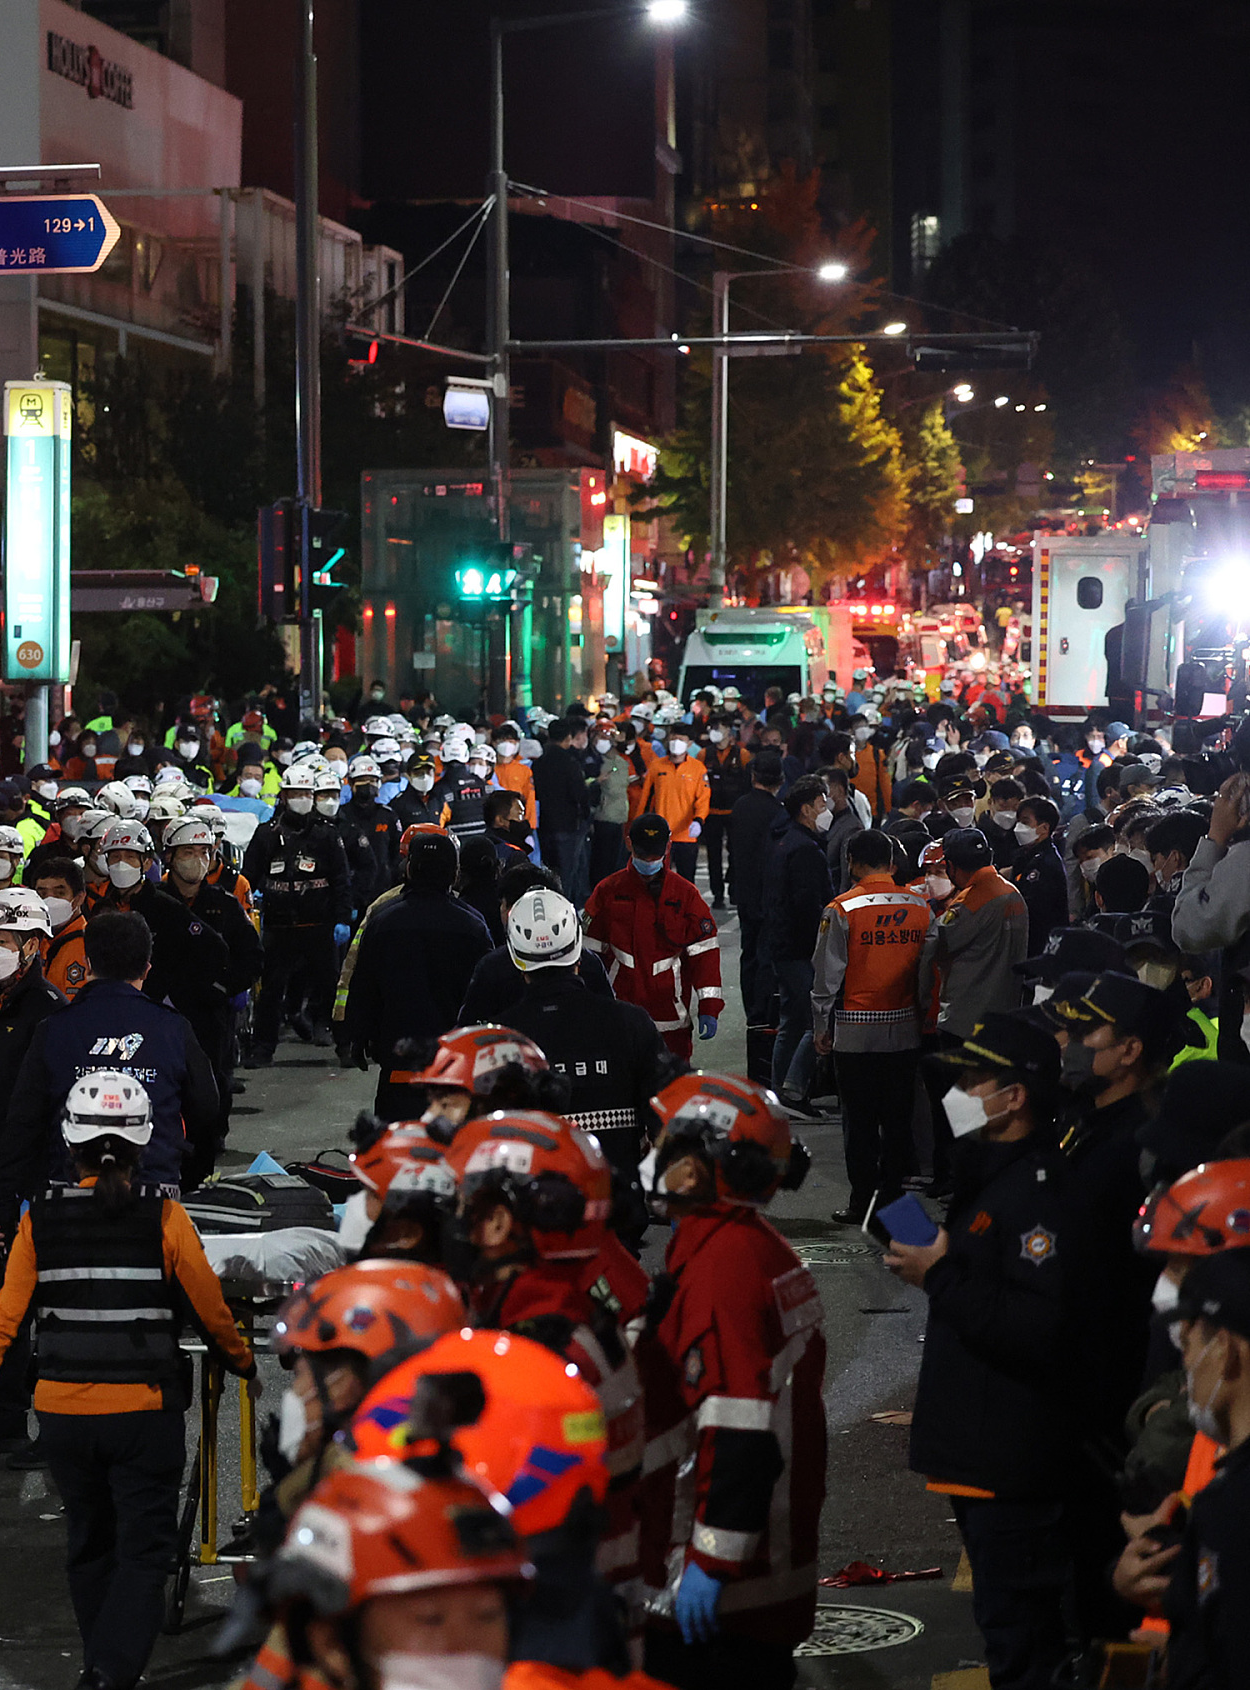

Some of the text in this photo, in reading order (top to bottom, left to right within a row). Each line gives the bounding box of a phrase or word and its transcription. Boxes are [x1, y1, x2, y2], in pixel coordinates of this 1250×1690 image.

[18, 648, 41, 661] 630
[875, 909, 908, 927] 119
[89, 1033, 144, 1060] 119
